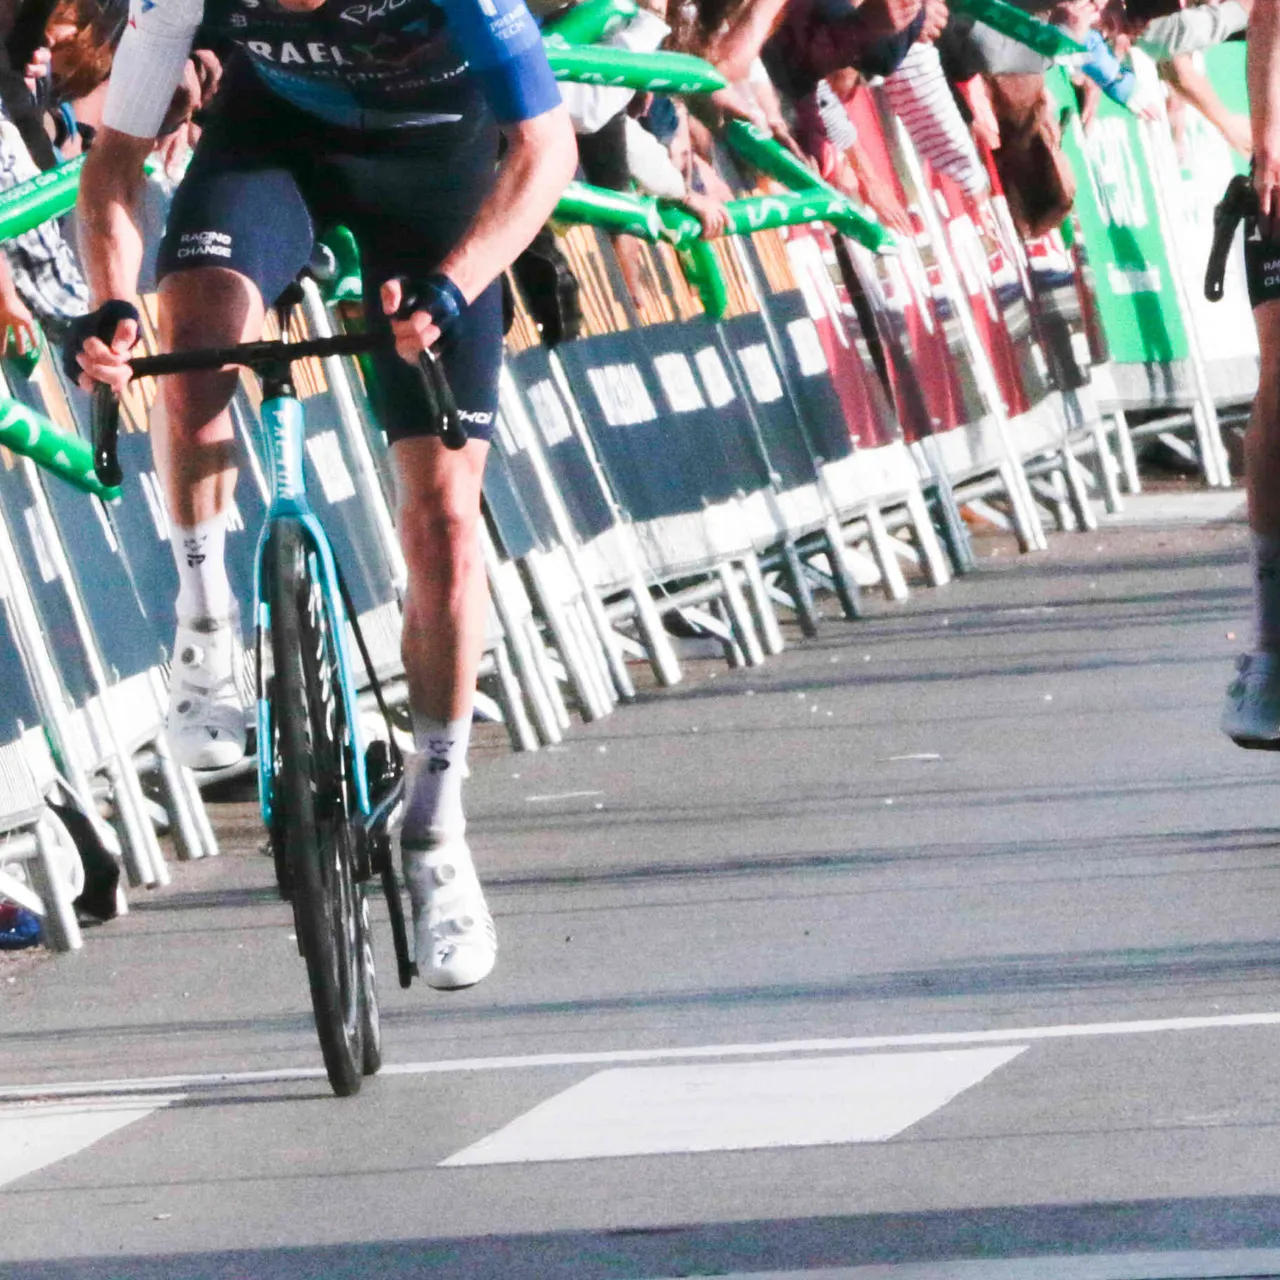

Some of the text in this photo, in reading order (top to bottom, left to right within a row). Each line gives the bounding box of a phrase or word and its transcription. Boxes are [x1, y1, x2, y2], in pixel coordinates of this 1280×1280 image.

[247, 40, 354, 66] RAEL
[180, 231, 232, 245] RACING
[178, 247, 232, 259] CHANGE
